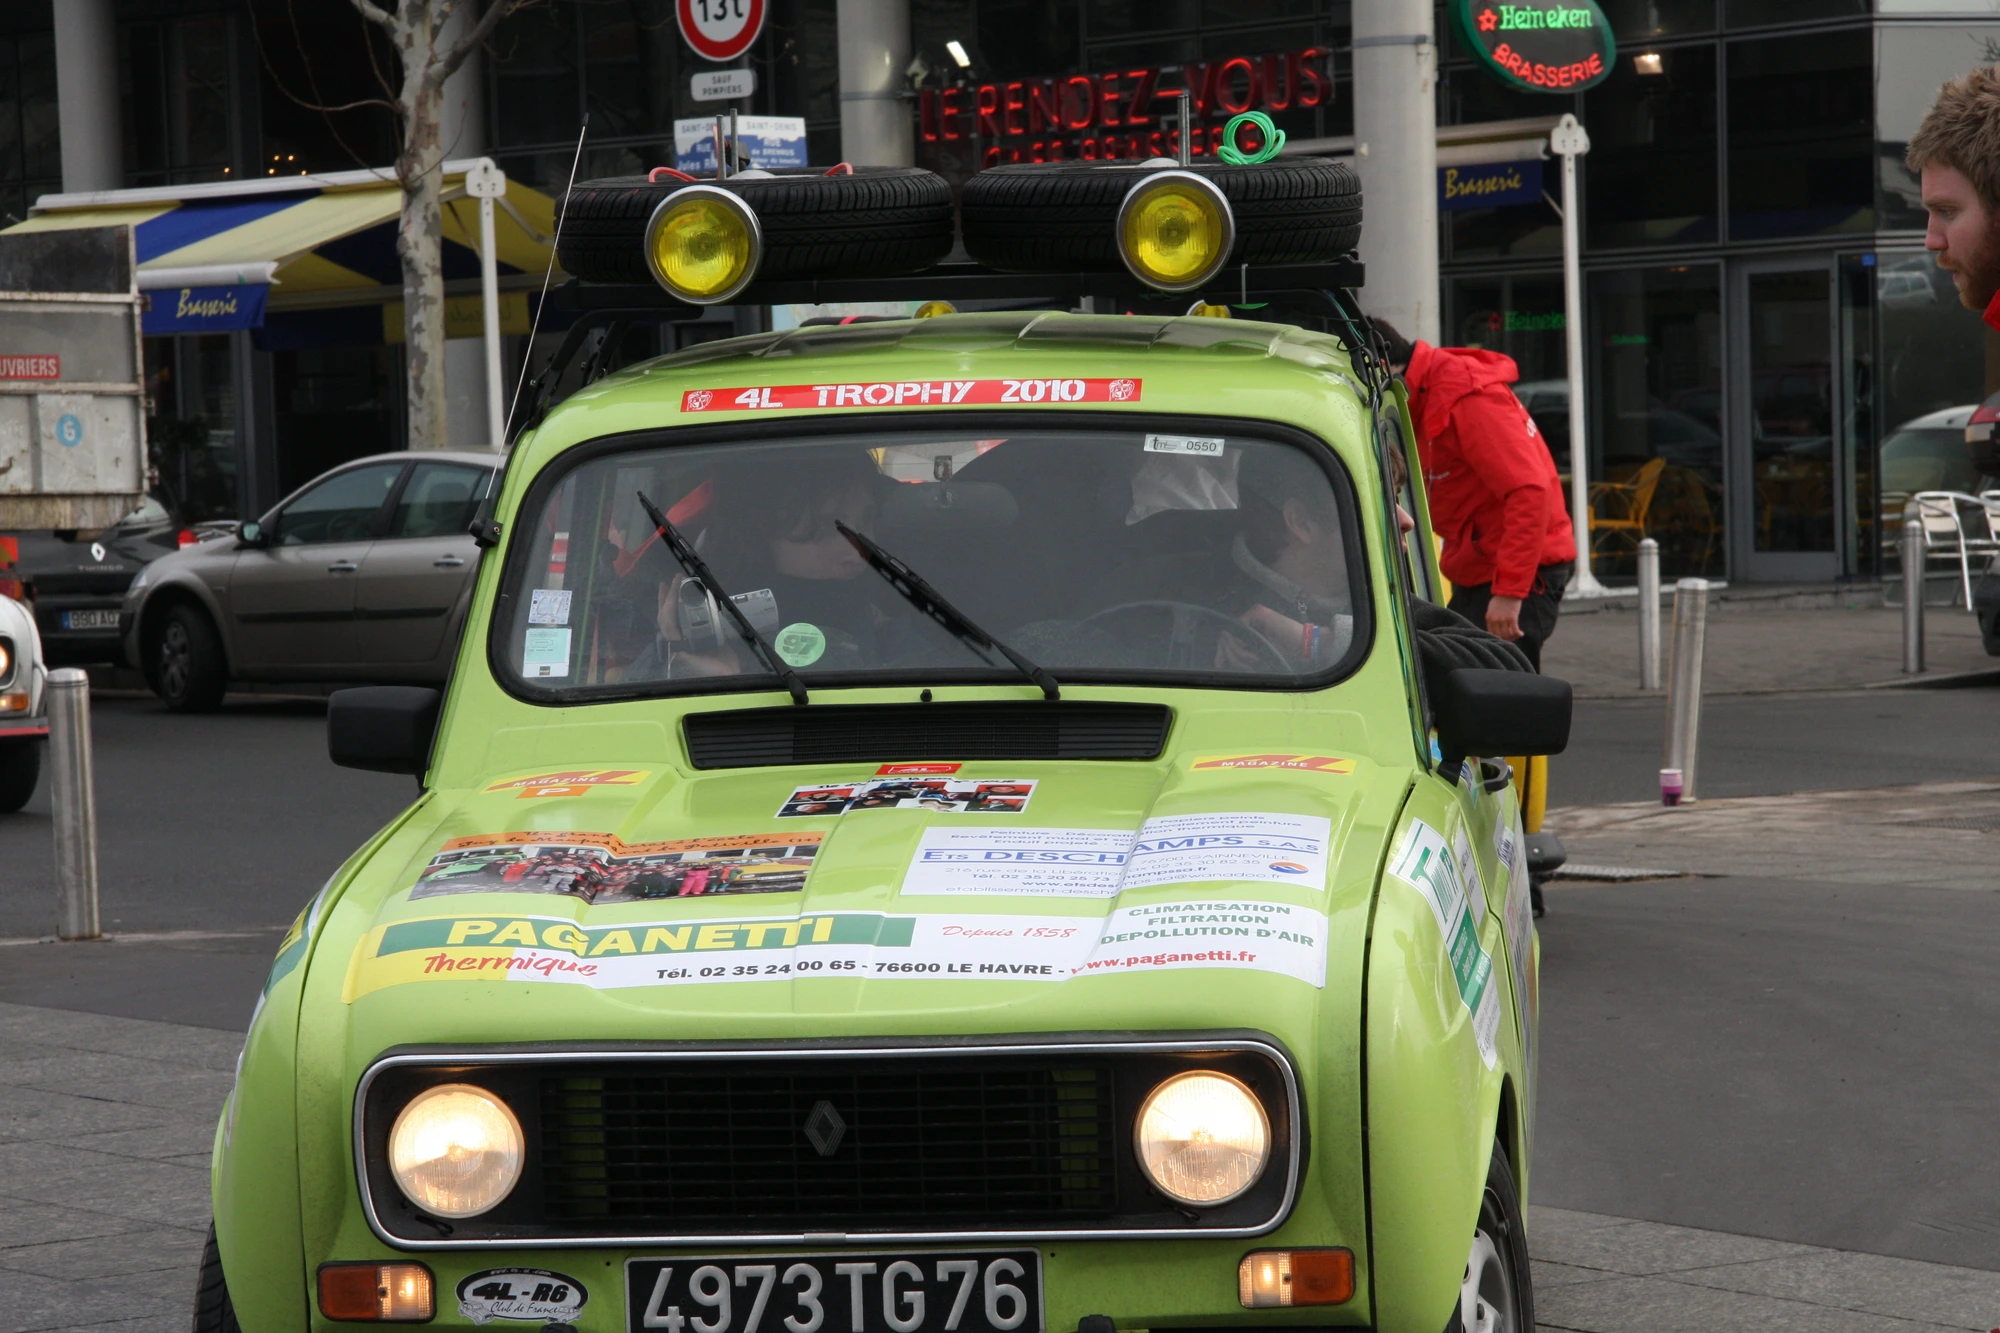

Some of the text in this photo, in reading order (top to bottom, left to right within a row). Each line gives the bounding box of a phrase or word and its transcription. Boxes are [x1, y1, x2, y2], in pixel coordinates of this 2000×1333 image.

[1498, 4, 1593, 30] Heineken
[1492, 43, 1604, 88] BRASSERIE
[711, 75, 733, 85] SAUF
[702, 85, 743, 96] POMPIERS
[920, 46, 1333, 141] LE RENDEZ-VOUS
[745, 120, 797, 133] SAINT-DENIS
[1445, 166, 1523, 199] Brasserie
[176, 288, 238, 318] Brasserie
[734, 378, 1086, 409] 4L TROPHY 2010
[1186, 440, 1217, 452] 0550
[782, 634, 819, 656] 97
[1221, 760, 1309, 768] MAGAZINE
[512, 776, 601, 788] MAGAZINE
[536, 787, 571, 796] P
[1177, 823, 1255, 833] thermique
[1238, 818, 1302, 827] peinture
[1187, 852, 1290, 861] GAINNEVILLE
[1128, 903, 1291, 917] CLIMATISATION
[1147, 914, 1270, 926] FILTRATION
[446, 916, 835, 956] PAGANETTI
[941, 925, 1077, 939] Depuis 1858
[1100, 926, 1315, 947] DEPOLLUTION D'AIR
[656, 967, 693, 979] Tél.
[699, 966, 726, 977] 02
[732, 965, 759, 976] 35
[764, 963, 791, 974] 24
[796, 960, 823, 971] 00
[829, 960, 856, 971] 65
[875, 962, 941, 973] 76600
[947, 963, 973, 973] LE
[979, 963, 1053, 975] HAVRE
[643, 1258, 1028, 1333] 4973 TG 76
[490, 1301, 558, 1314] Club de France
